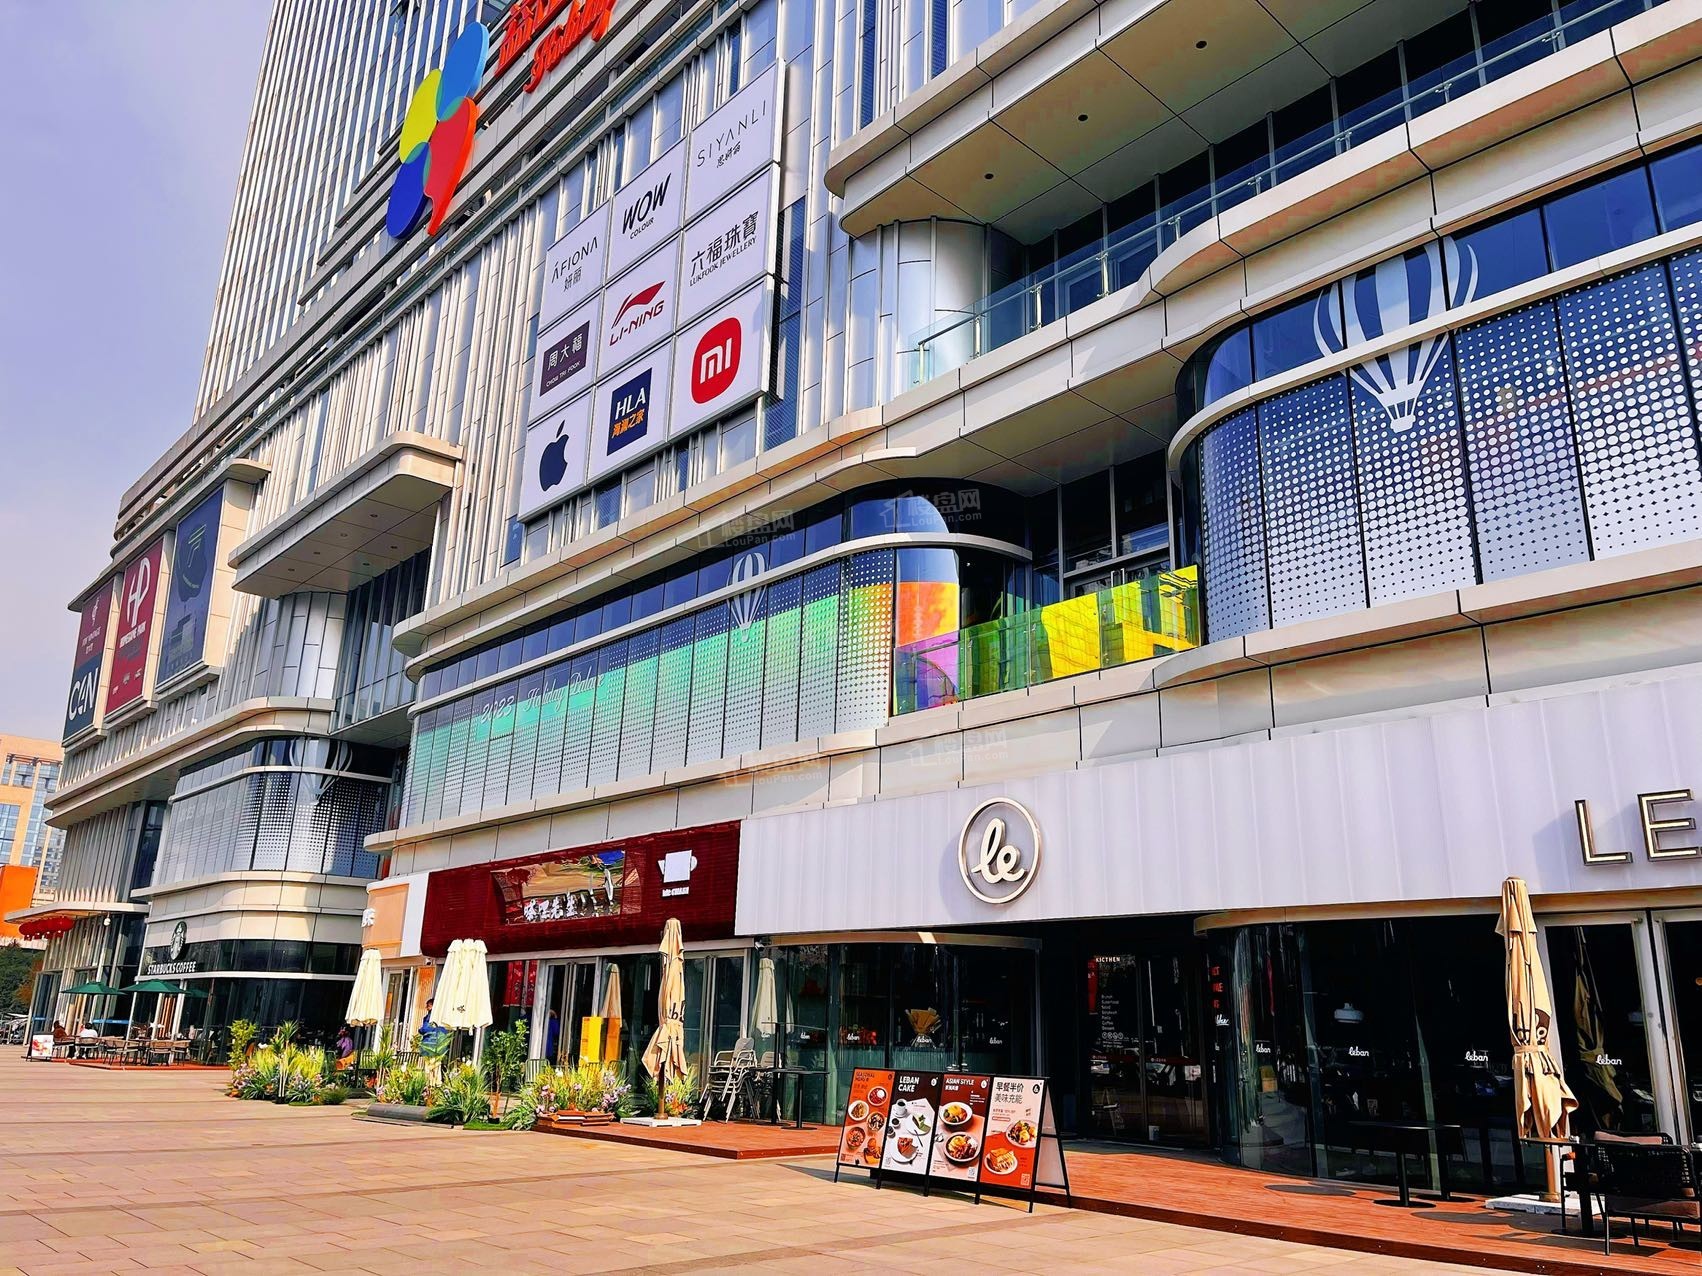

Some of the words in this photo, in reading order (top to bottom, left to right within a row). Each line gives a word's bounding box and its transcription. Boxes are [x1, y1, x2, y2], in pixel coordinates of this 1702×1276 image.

[622, 173, 671, 234] WOW
[630, 218, 654, 239] COLOUR
[691, 211, 759, 277] 六福珠寶
[690, 263, 719, 287] LUKFOOK
[719, 236, 757, 270] JEWELLERY
[610, 300, 664, 347] LI-NING
[548, 333, 583, 371] 周大福
[615, 387, 646, 420] HLA
[525, 678, 564, 712] Holiday
[971, 817, 1027, 884] le
[147, 962, 176, 975] STARBUCKS
[175, 961, 197, 973] COFFEE
[1348, 1046, 1370, 1058] leban
[1464, 1050, 1489, 1062] leban
[1595, 1053, 1623, 1066] leban
[898, 1083, 915, 1093] CAKE
[899, 1076, 920, 1085] LEBAN
[960, 1078, 974, 1086] STYLE
[996, 1081, 1024, 1093] 早餐半价
[994, 1093, 1023, 1104] 美味充能
